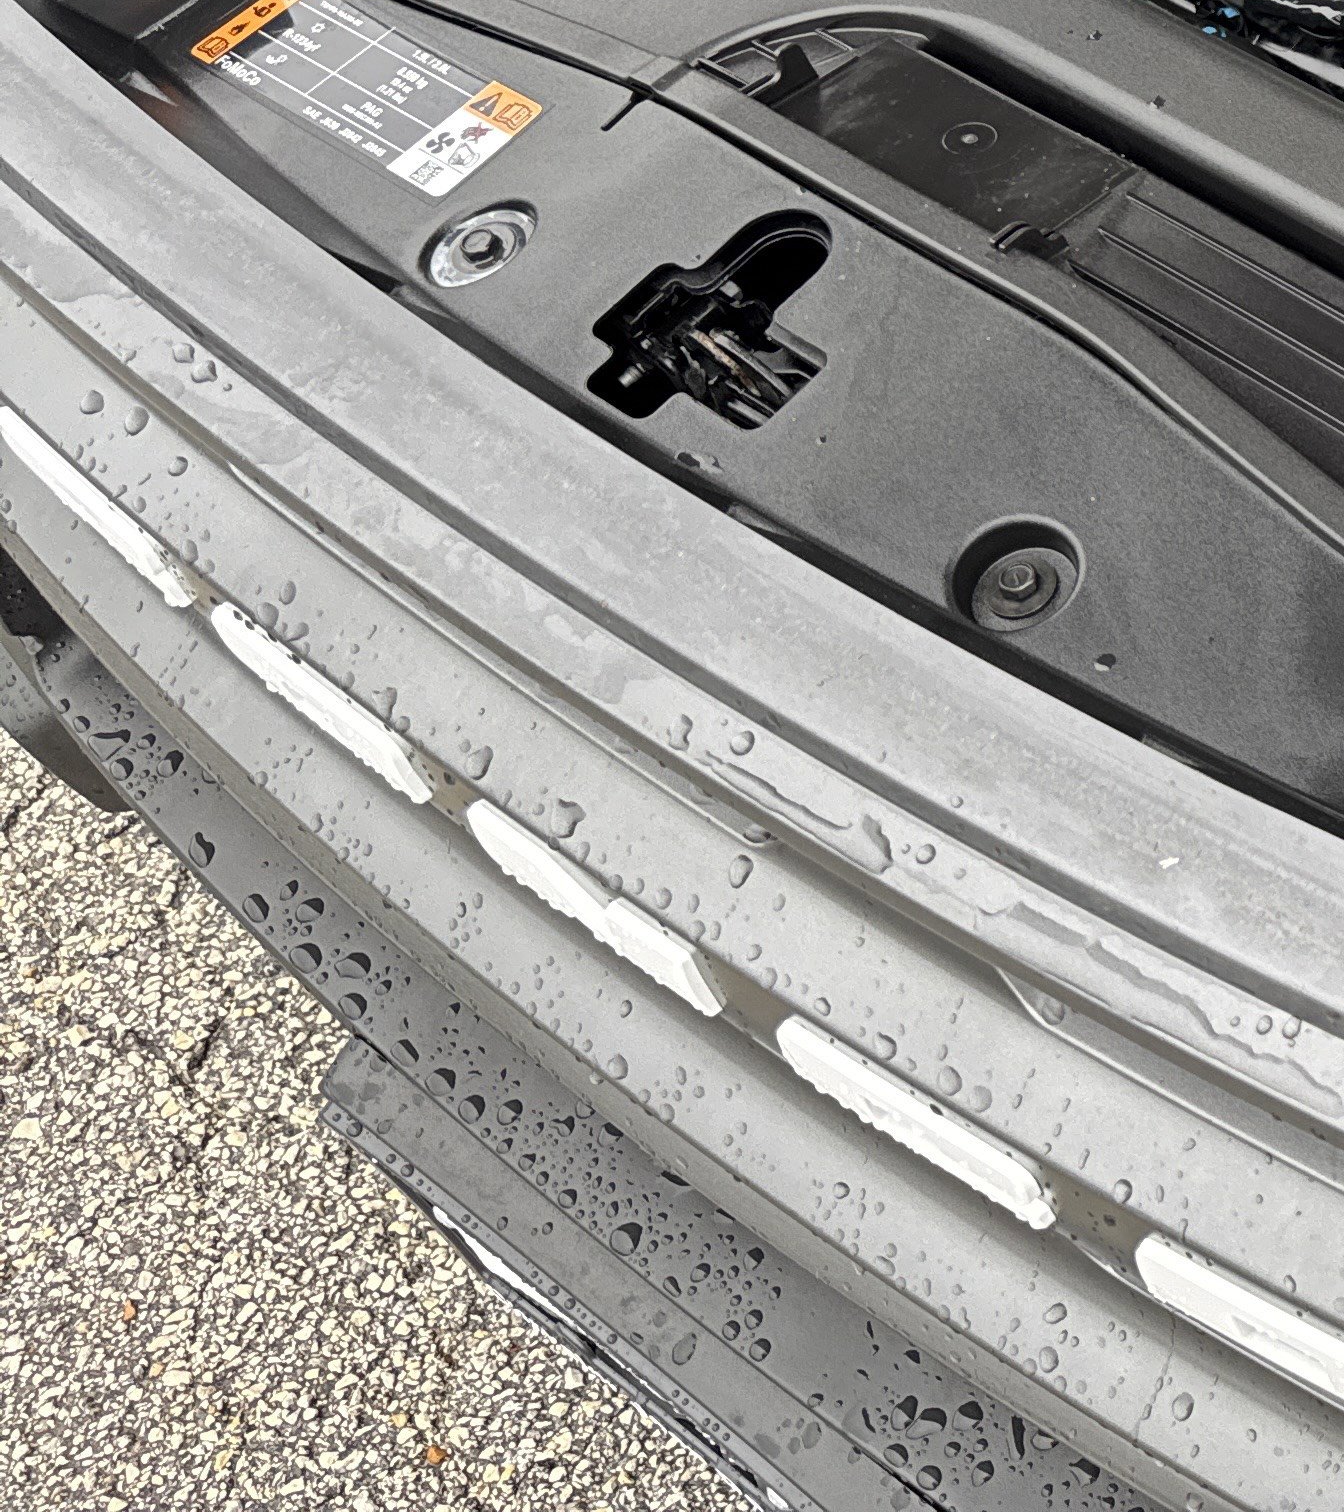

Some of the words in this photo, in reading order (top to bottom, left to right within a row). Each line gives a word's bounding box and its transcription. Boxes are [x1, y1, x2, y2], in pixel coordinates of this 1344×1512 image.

[215, 55, 261, 87] FoMoCo
[302, 105, 321, 120] SAE
[360, 100, 384, 119] PAG
